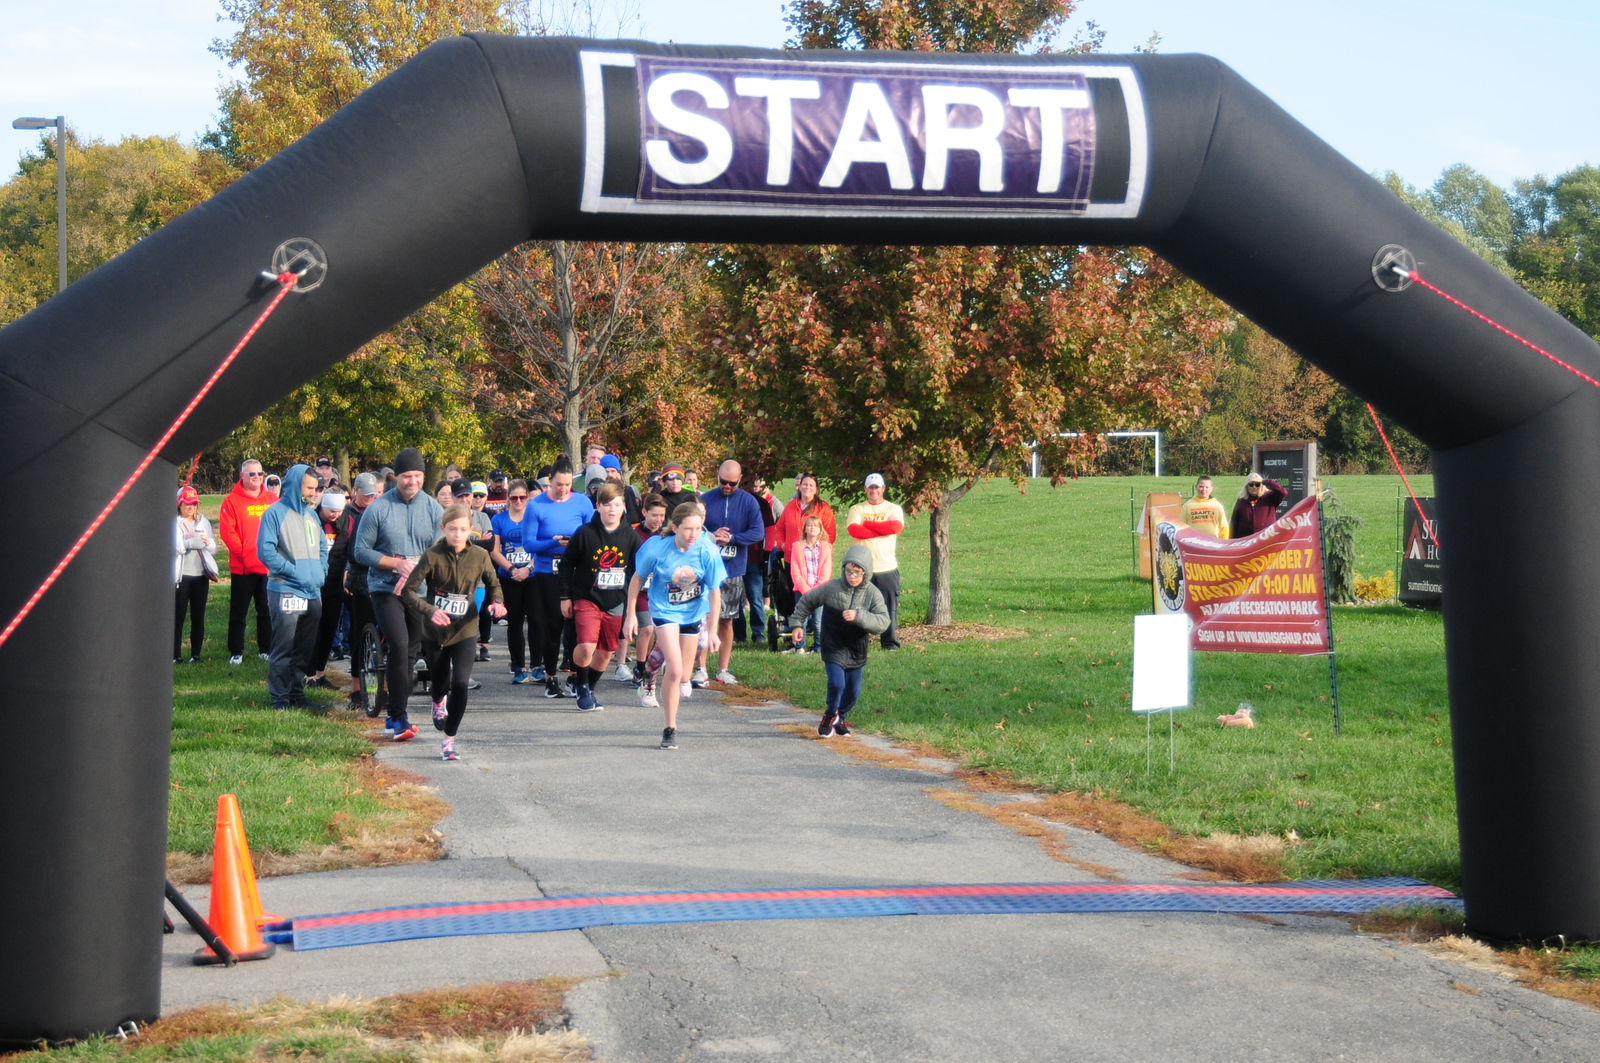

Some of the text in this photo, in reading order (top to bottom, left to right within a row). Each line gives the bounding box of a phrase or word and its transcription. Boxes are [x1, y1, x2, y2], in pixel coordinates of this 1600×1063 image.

[645, 71, 1090, 193] START
[507, 553, 530, 562] 4752
[1234, 549, 1303, 574] NOVEMBER
[1304, 549, 1313, 569] 7
[599, 573, 624, 585] 4762
[670, 587, 700, 601] 4758
[1188, 576, 1252, 602] STARTING
[1250, 575, 1263, 595] AT
[1263, 574, 1290, 595] 9:00
[1292, 573, 1317, 594] AM
[283, 599, 306, 610] 4917
[435, 597, 467, 614] 4760
[1200, 602, 1214, 616] AT
[1240, 601, 1291, 615] RECREATION
[1291, 600, 1319, 615] PARK
[1198, 629, 1323, 645] SIGN UP AT WWW.RUNSIGNUP.COM
